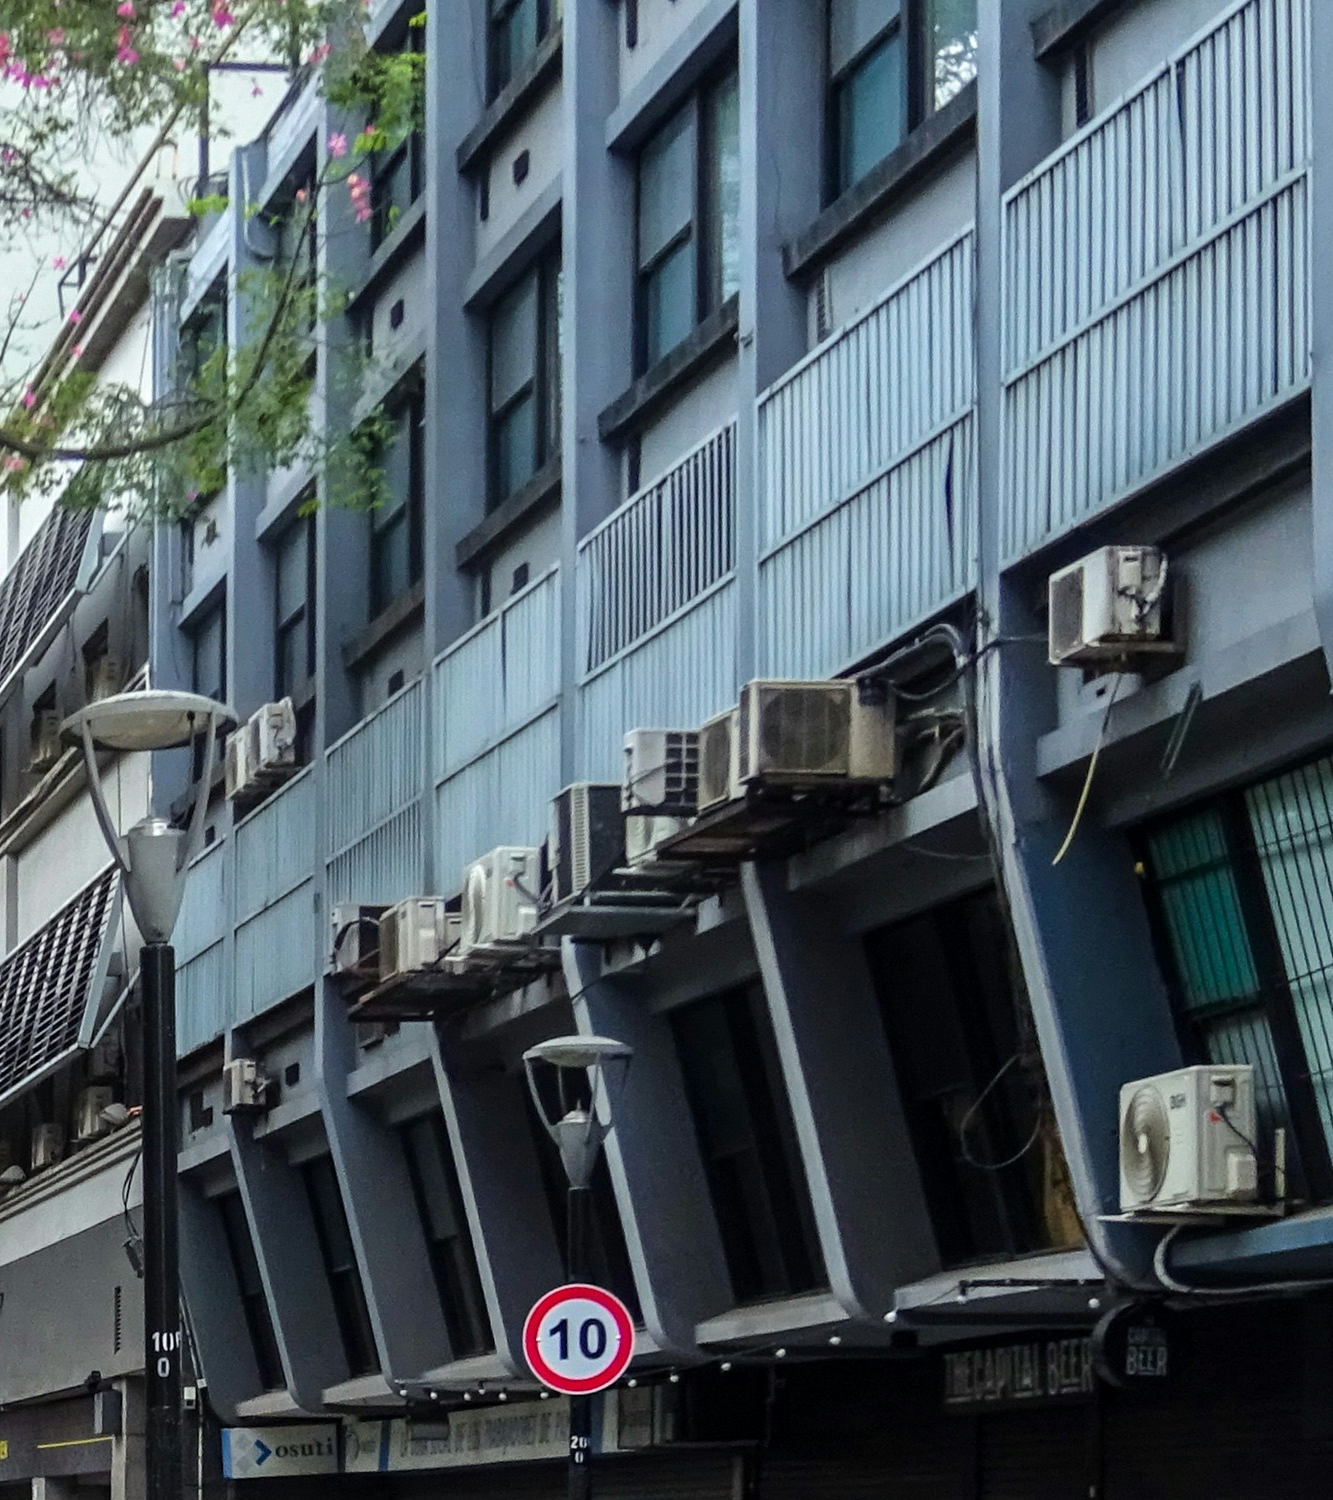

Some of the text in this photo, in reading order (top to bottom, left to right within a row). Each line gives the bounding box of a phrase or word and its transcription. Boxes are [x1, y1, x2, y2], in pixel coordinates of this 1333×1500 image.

[549, 1318, 607, 1361] 10
[1126, 1346, 1168, 1376] BEER
[1047, 1338, 1094, 1396] BEER
